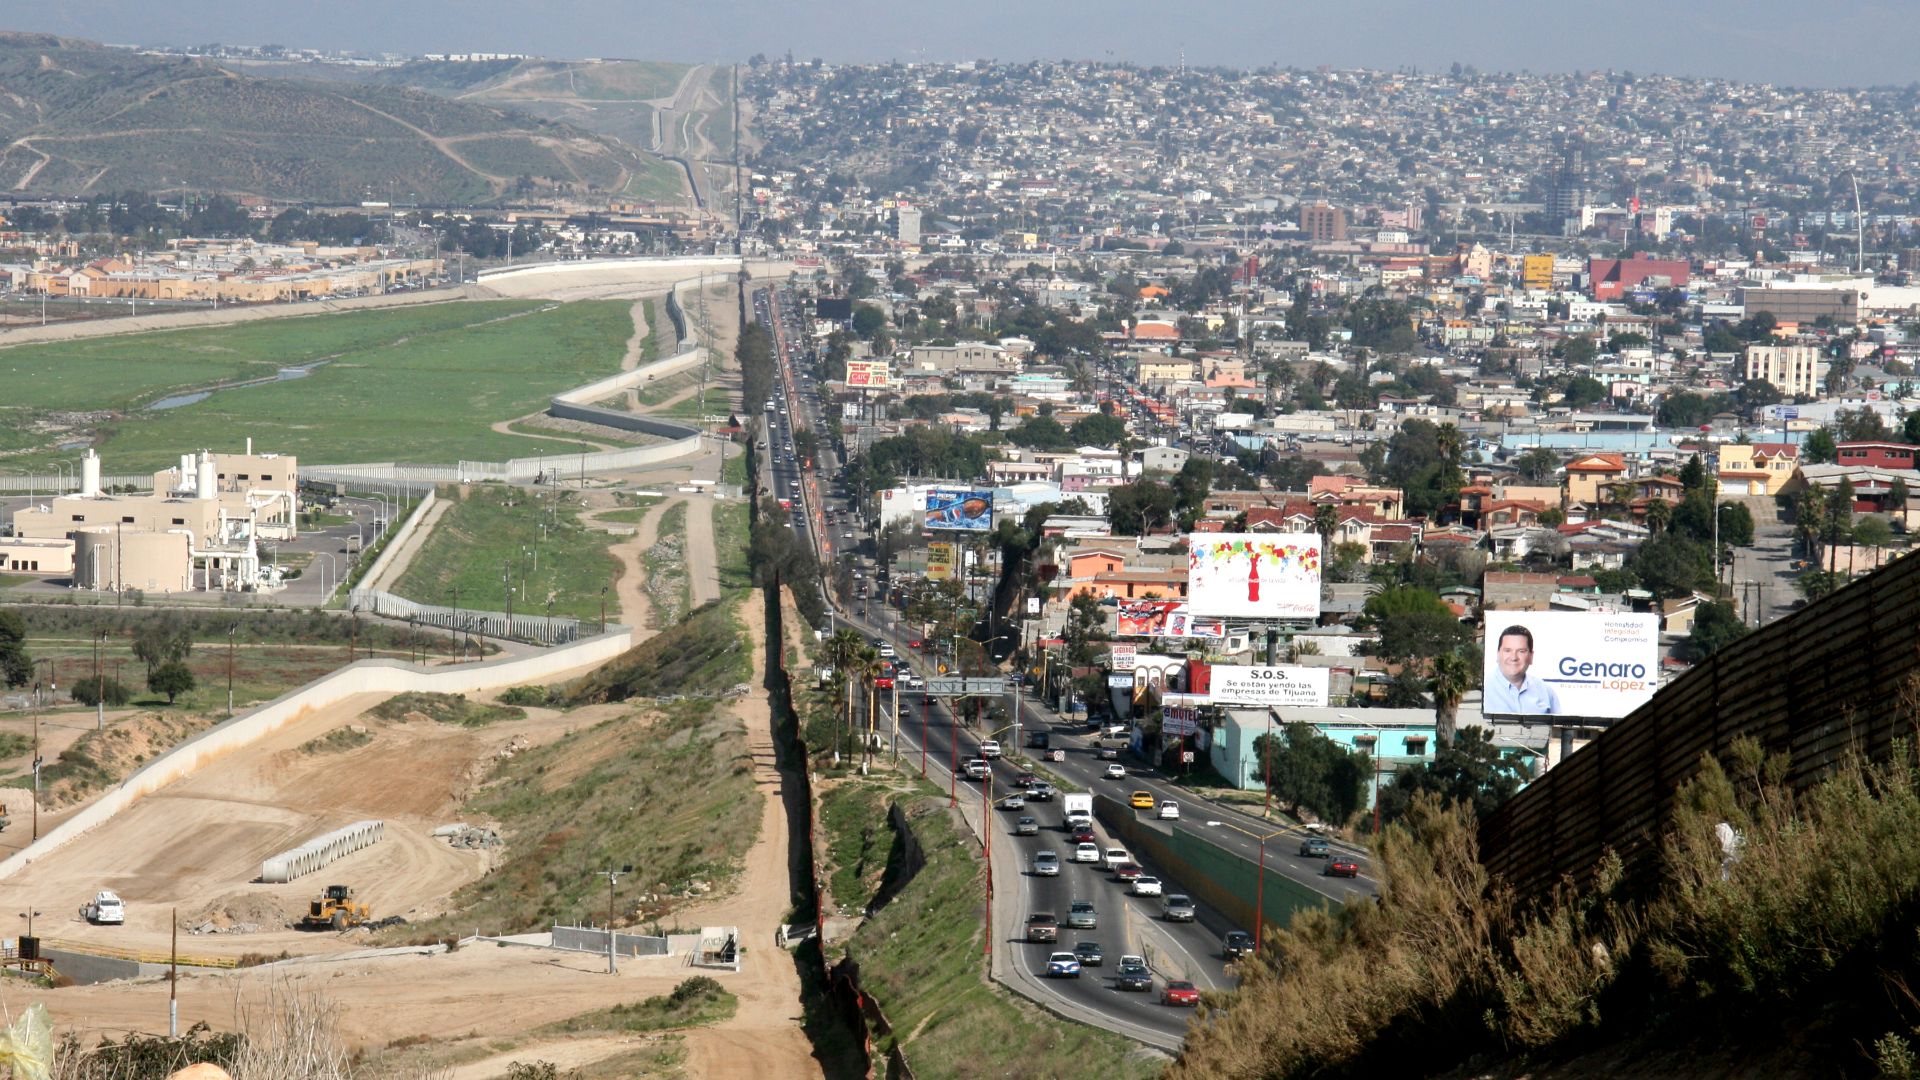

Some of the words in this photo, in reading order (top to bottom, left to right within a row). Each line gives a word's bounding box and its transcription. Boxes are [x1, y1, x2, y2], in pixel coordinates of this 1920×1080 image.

[1558, 656, 1646, 679] Genaro
[1251, 670, 1288, 680] S.O.S.
[1602, 679, 1645, 692] López
[1221, 688, 1266, 696] empresas
[1283, 688, 1316, 697] Tijuana
[1170, 707, 1199, 721] MOTEL
